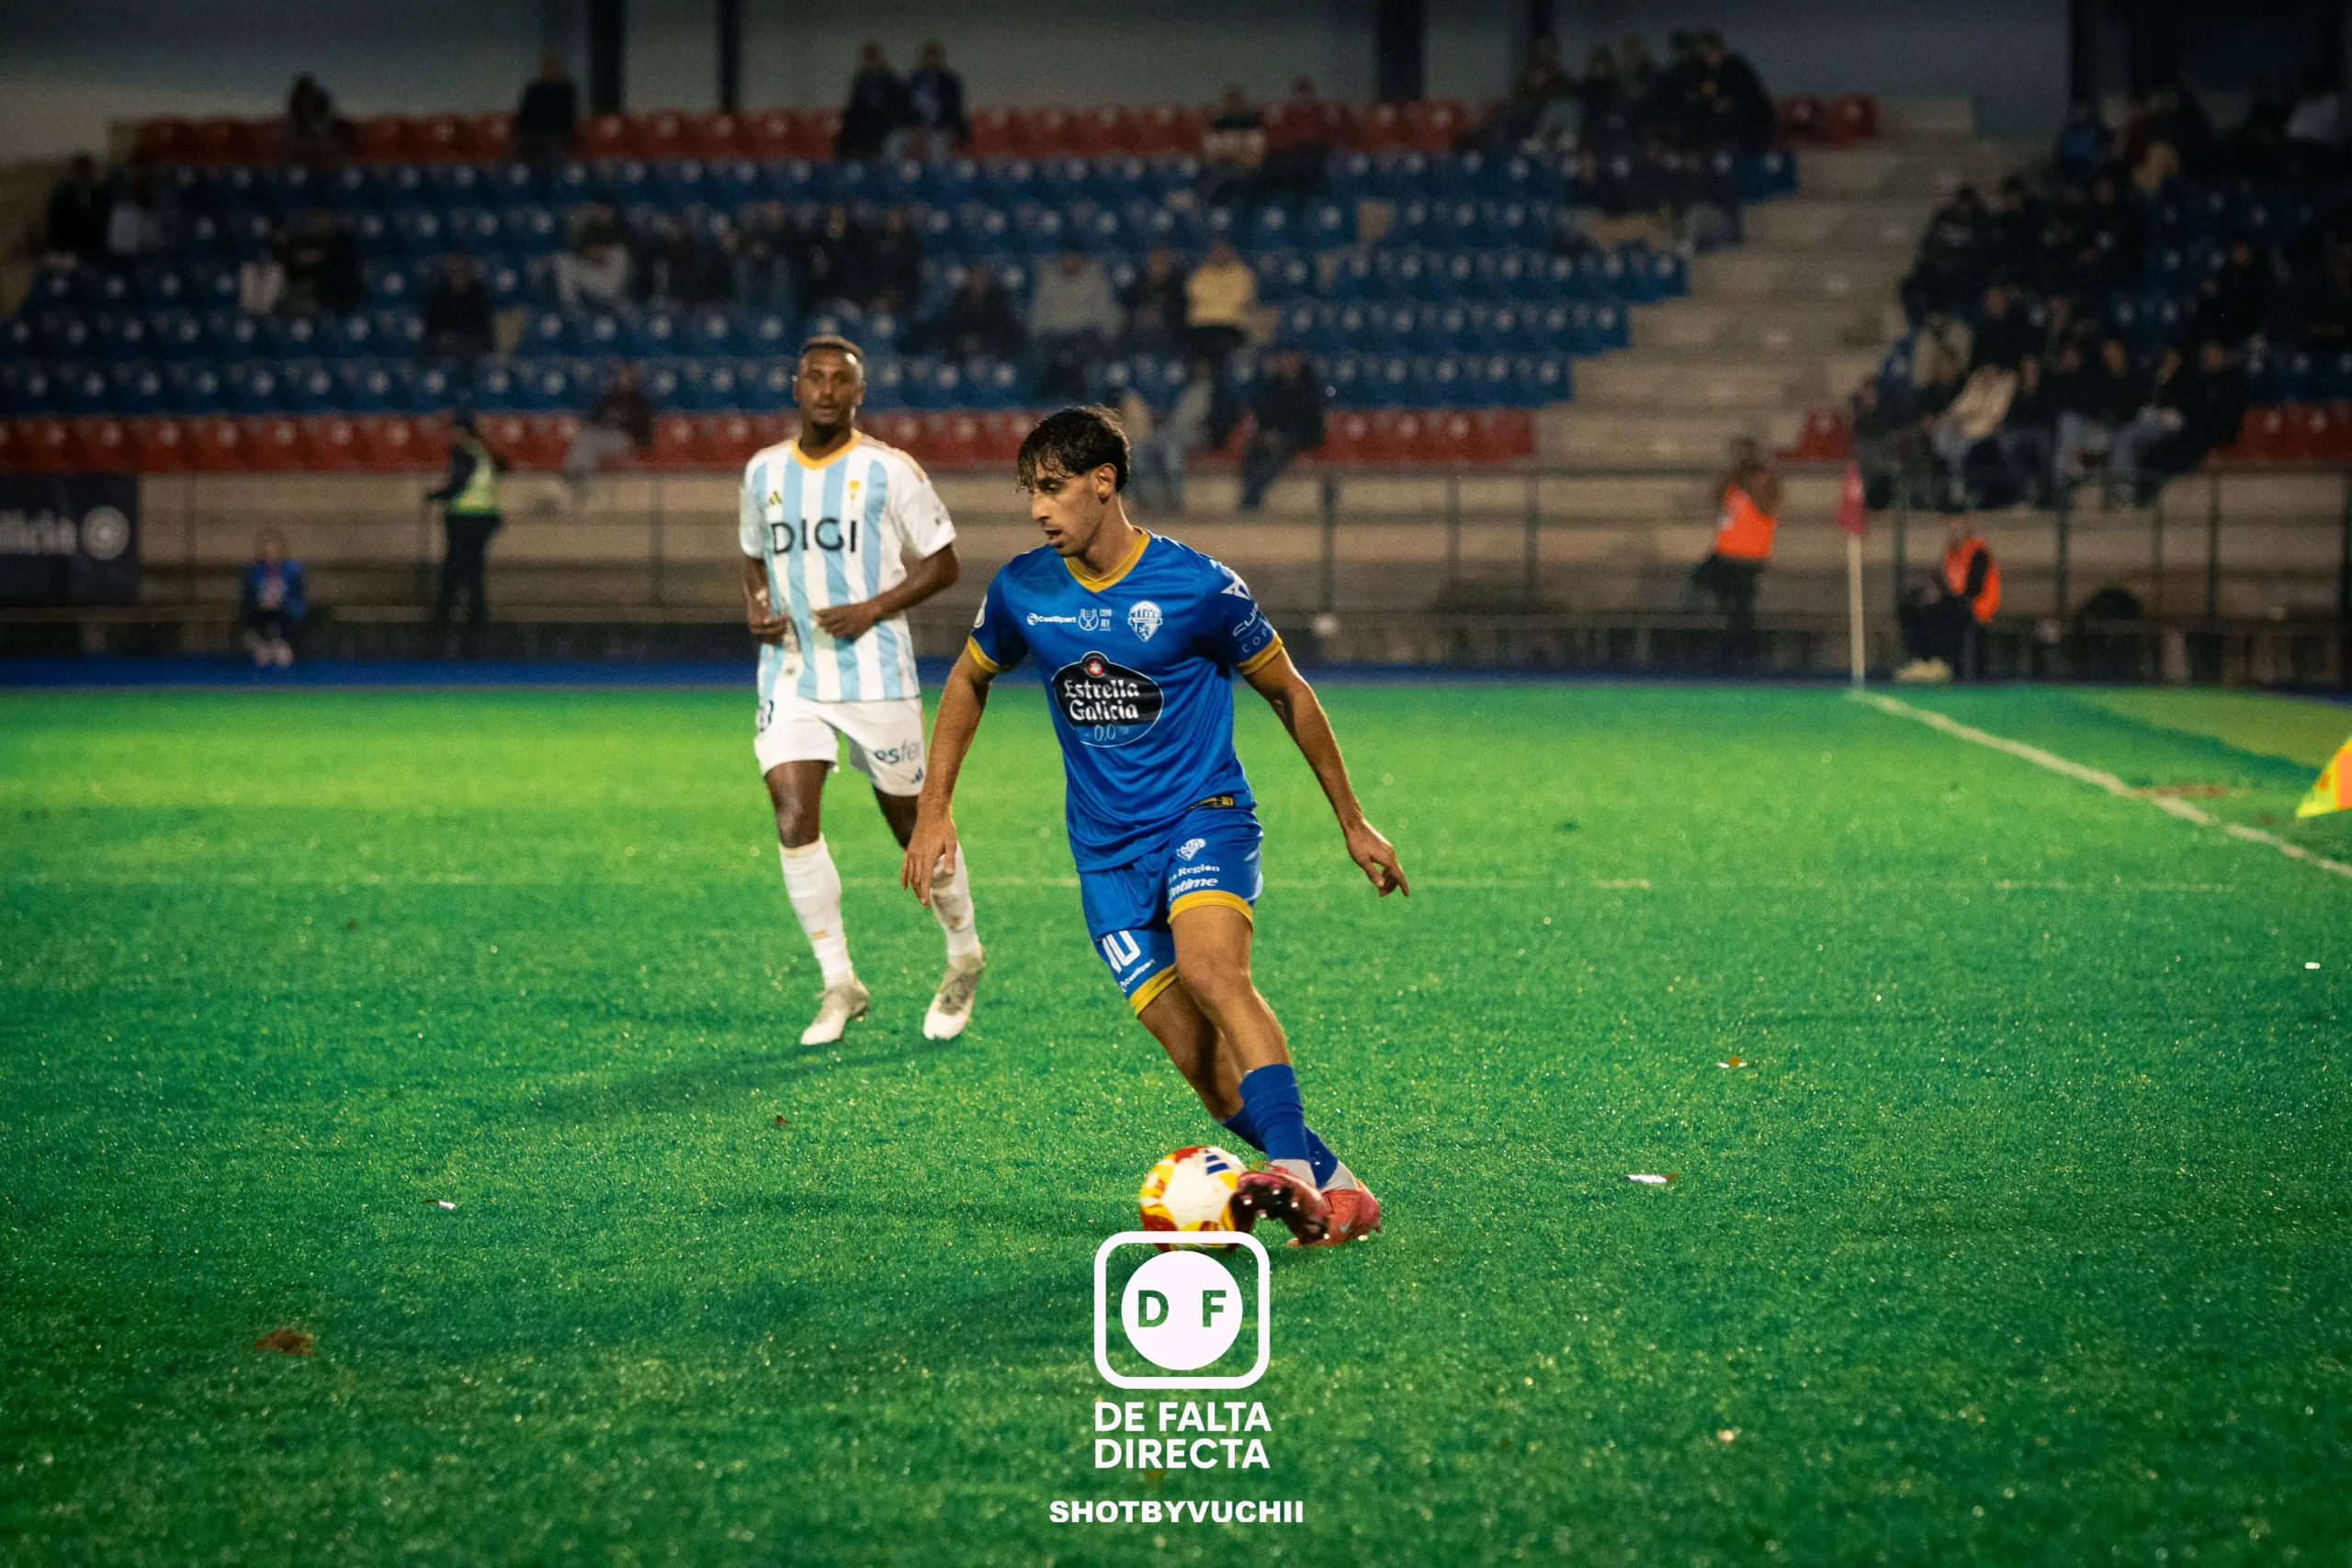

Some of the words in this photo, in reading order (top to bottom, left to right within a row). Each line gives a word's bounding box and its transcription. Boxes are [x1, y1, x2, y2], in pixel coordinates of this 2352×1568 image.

[770, 518, 857, 555] DIGI
[1064, 679, 1140, 699] Estrella
[1069, 699, 1139, 721] Galicia
